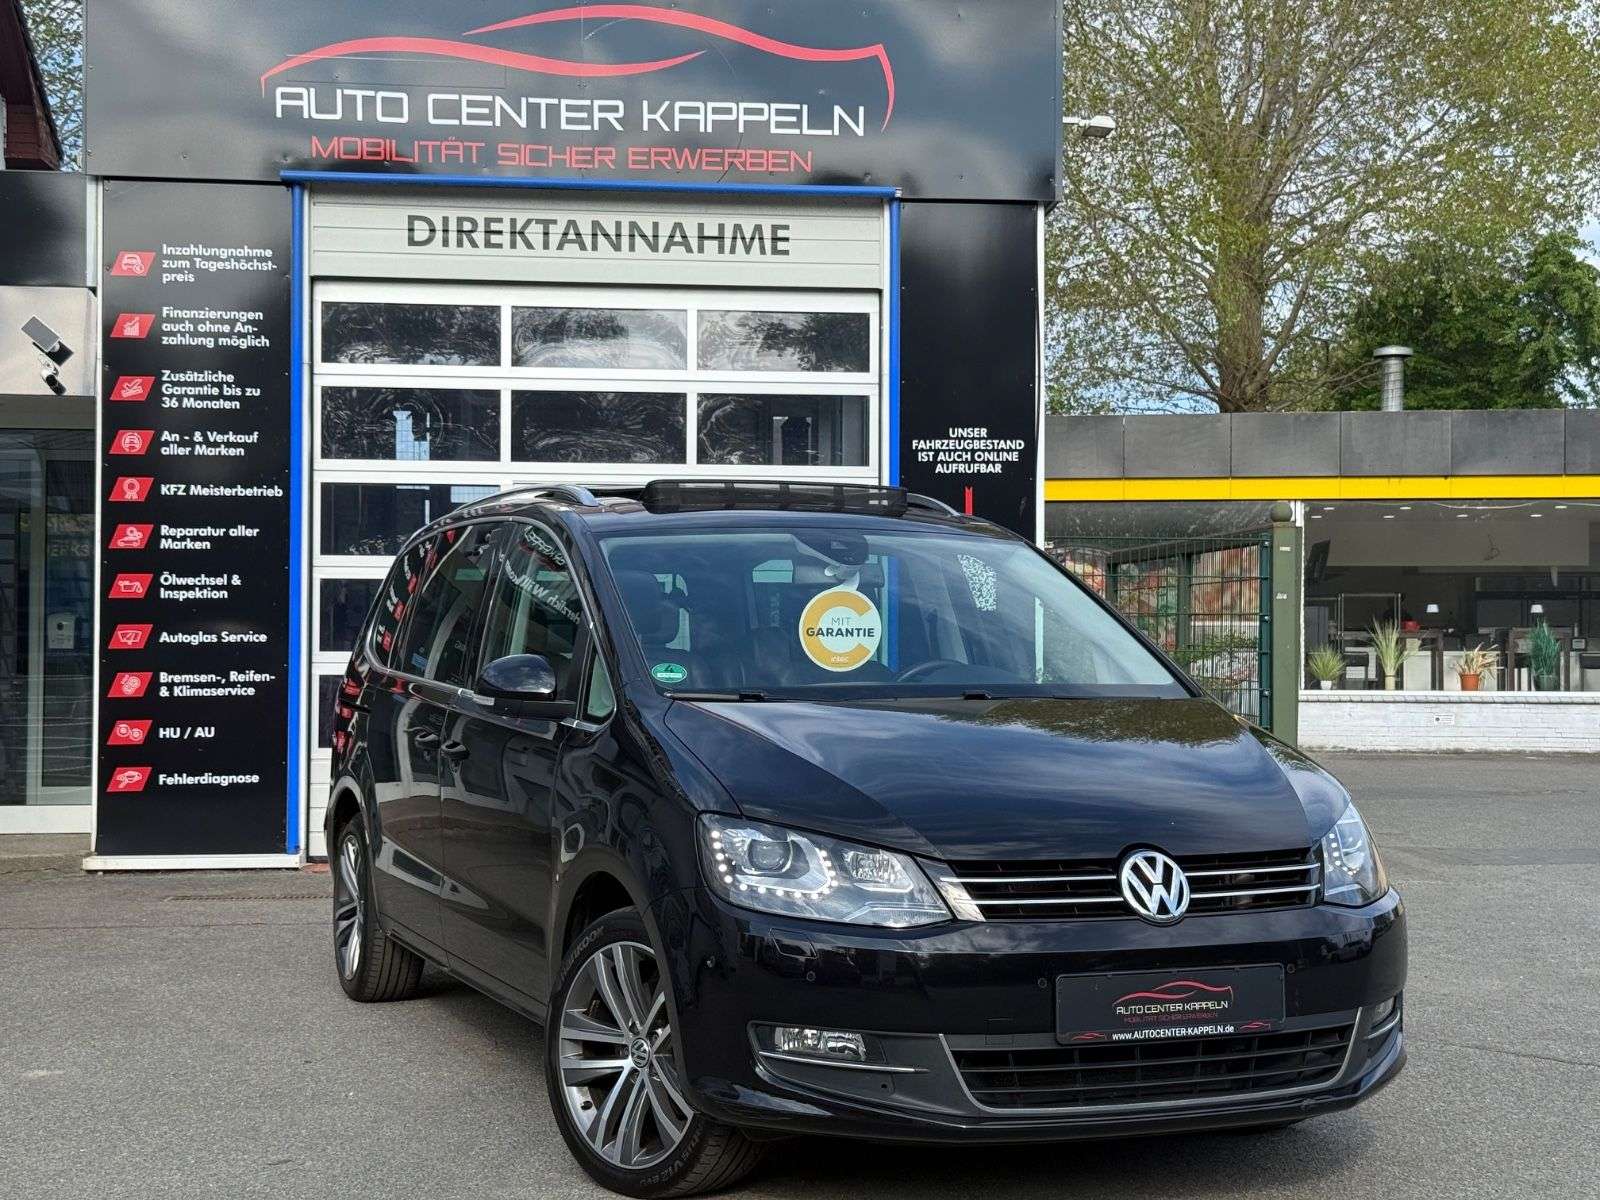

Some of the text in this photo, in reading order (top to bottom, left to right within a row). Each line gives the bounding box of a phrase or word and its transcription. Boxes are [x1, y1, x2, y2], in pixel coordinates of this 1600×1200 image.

[275, 86, 865, 137] AUTO CENTER KAPPELN
[311, 136, 813, 173] MOBILITÄT SICHER ERWERBEN
[406, 214, 790, 256] DIREKTANNAHME
[162, 244, 273, 259] Inzahlungnahme
[162, 257, 278, 272] zum Tageshöchst-
[162, 270, 196, 284] preis
[162, 306, 264, 322] Finanzierungen
[161, 321, 259, 333] auch ohne An-
[161, 333, 270, 349] zahlung möglich
[161, 370, 235, 383] Zusätzliche
[161, 384, 261, 397] Garantie bis zu
[161, 397, 241, 410] 36 Monaten
[161, 430, 180, 442] An
[193, 431, 204, 442] &
[206, 431, 260, 443] Verkauf
[949, 427, 988, 438] UNSER
[160, 444, 245, 456] aller Marken
[912, 439, 1025, 450] FAHRZEUGBESTAND
[918, 451, 1019, 462] IST AUCH ONLINE
[935, 463, 1003, 474] AUFRUFBAR
[160, 484, 284, 498] KFZ Meisterbetrieb
[160, 525, 260, 539] Reparatur aller
[160, 538, 211, 550] Marken
[160, 571, 242, 586] Ölwechsel &
[160, 587, 229, 602] Inspektion
[831, 617, 850, 627] MIT
[159, 631, 268, 645] Autoglas Service
[806, 627, 876, 638] GARANTIE
[159, 670, 276, 684] Bremsen-, Reifen-
[159, 684, 256, 698] & Klimaservice
[159, 726, 216, 739] HU / AU
[158, 773, 260, 787] Fehlerdiagnose
[1116, 1000, 1229, 1015] AUTO CENTER KAPPELN
[1111, 1024, 1235, 1041] www.AUTOCENTER-KAPPELN.de
